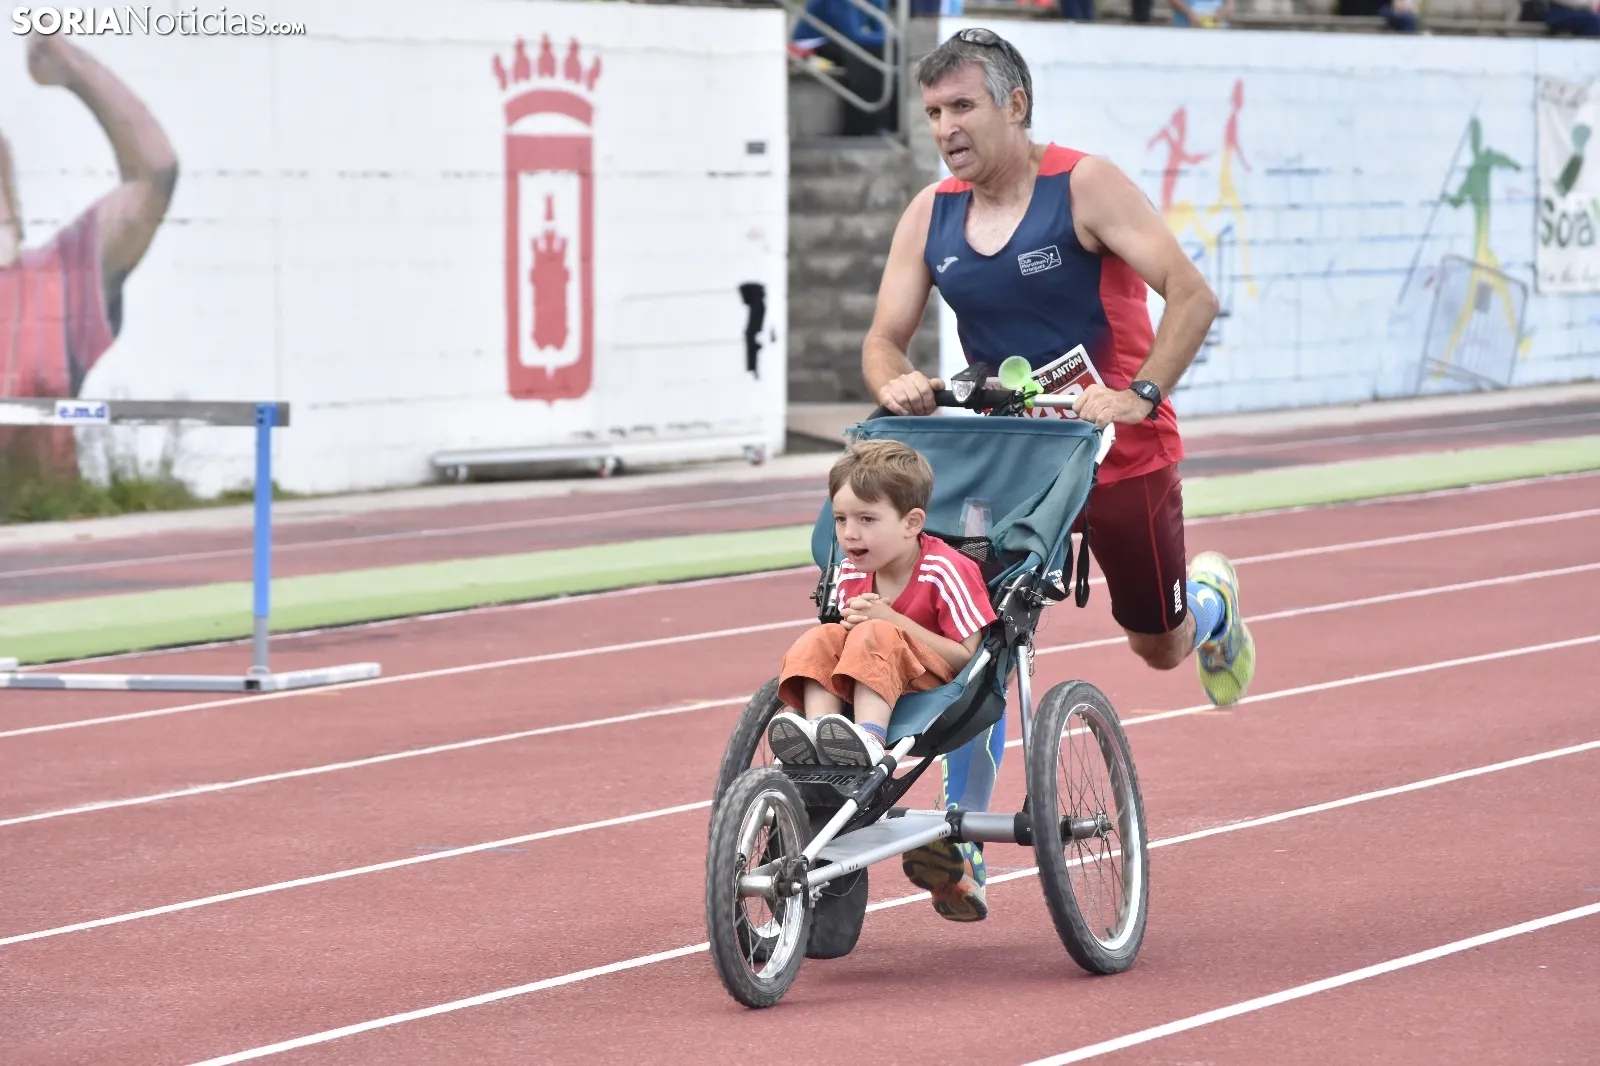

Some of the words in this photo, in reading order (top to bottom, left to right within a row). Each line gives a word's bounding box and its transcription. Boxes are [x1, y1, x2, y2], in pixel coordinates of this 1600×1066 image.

[1047, 380, 1059, 391] DE
[1060, 363, 1085, 383] SORIA
[1052, 355, 1083, 380] ANTÓN
